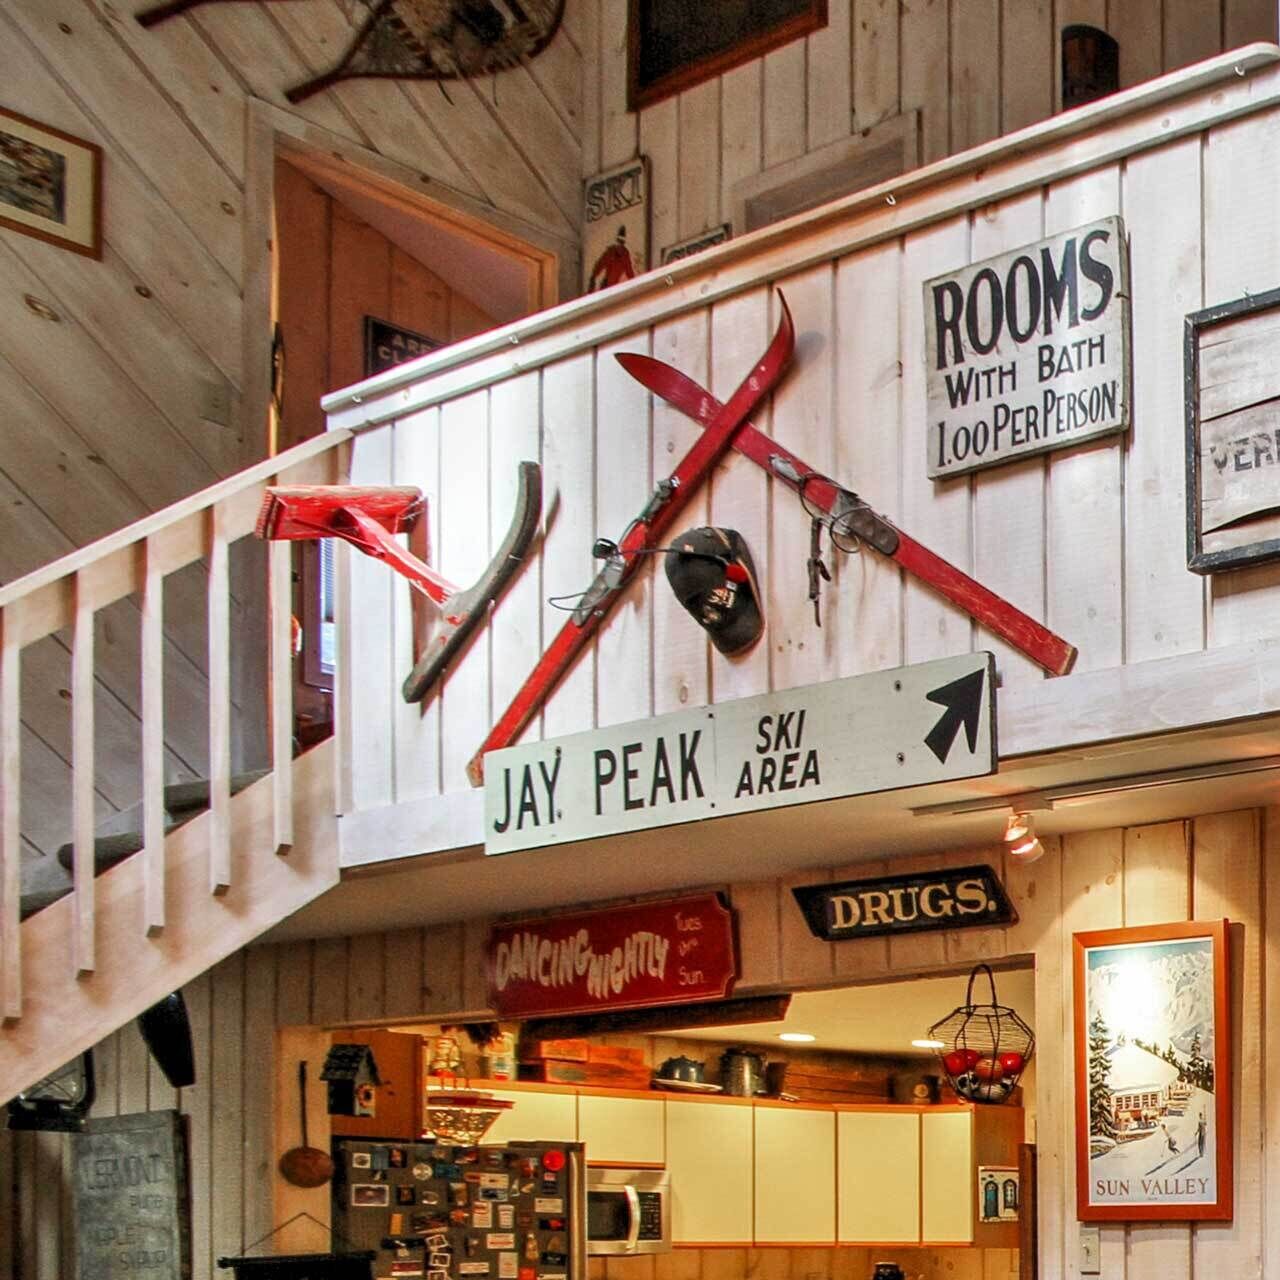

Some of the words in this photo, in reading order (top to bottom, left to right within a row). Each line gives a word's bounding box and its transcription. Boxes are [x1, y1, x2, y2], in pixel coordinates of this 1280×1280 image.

[586, 168, 643, 223] SKI
[932, 229, 1114, 370] ROOMS
[944, 361, 1017, 409] WITH
[1038, 334, 1106, 383] BATH
[993, 402, 1041, 451] PER
[1042, 380, 1118, 438] PERSON
[755, 708, 807, 755] SKI
[493, 754, 562, 834] JAY
[593, 729, 705, 816] PEAK
[734, 749, 821, 799] AREA
[831, 878, 998, 930] DRUGS.
[495, 928, 593, 991] DANCING
[586, 931, 670, 1000] NIGHTLY
[1095, 1179, 1130, 1196] SUN
[1140, 1177, 1209, 1196] VALLEY
